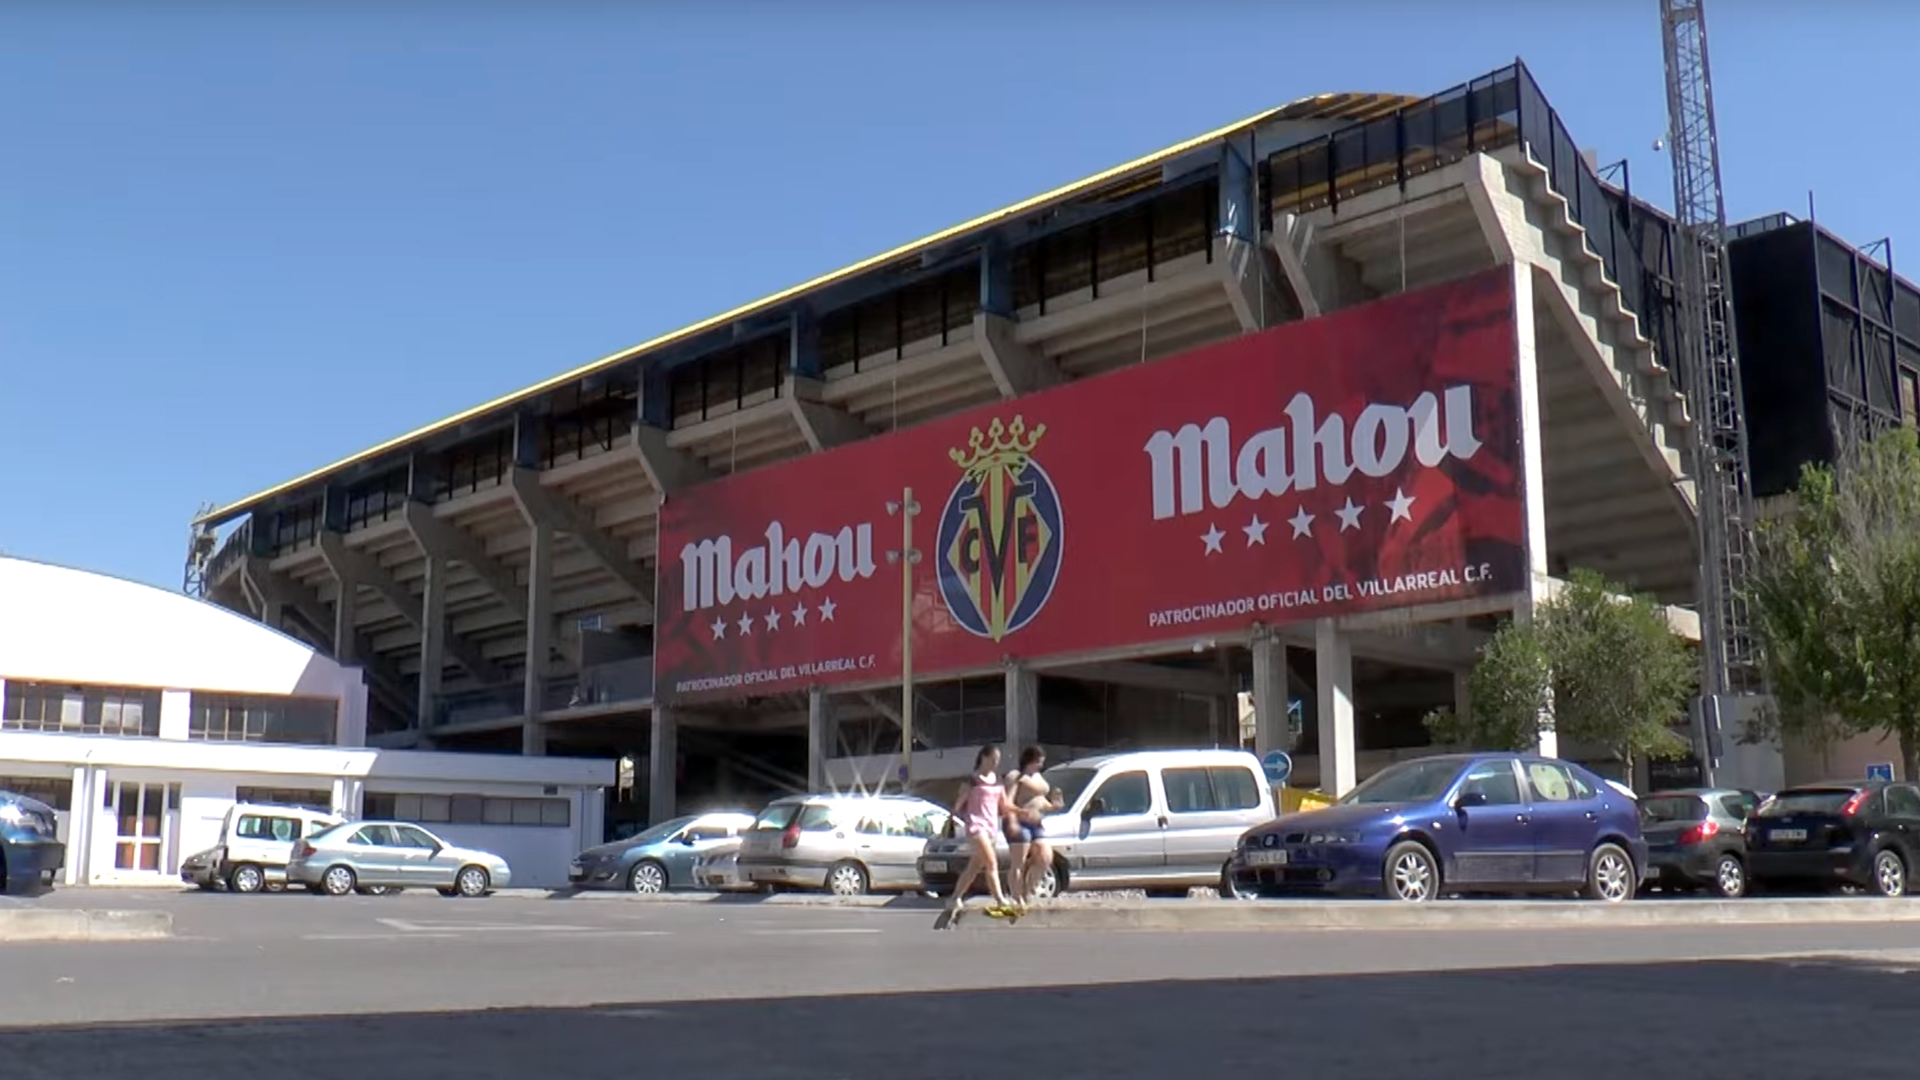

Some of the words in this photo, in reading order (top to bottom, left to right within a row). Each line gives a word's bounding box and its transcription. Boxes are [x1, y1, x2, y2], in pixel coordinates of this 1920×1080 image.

[1149, 597, 1255, 627] PATROCINADOR
[1258, 589, 1319, 610] OFICIAL
[1323, 584, 1353, 602] DEL
[1356, 569, 1460, 598] VILLARREAL
[1464, 562, 1493, 583] C.F.
[676, 673, 743, 693] PATROCINADOR
[744, 669, 779, 685] OFICIAL
[780, 664, 797, 680] DEL
[798, 658, 856, 676] VILLARREAL
[859, 654, 876, 669] C.F.
